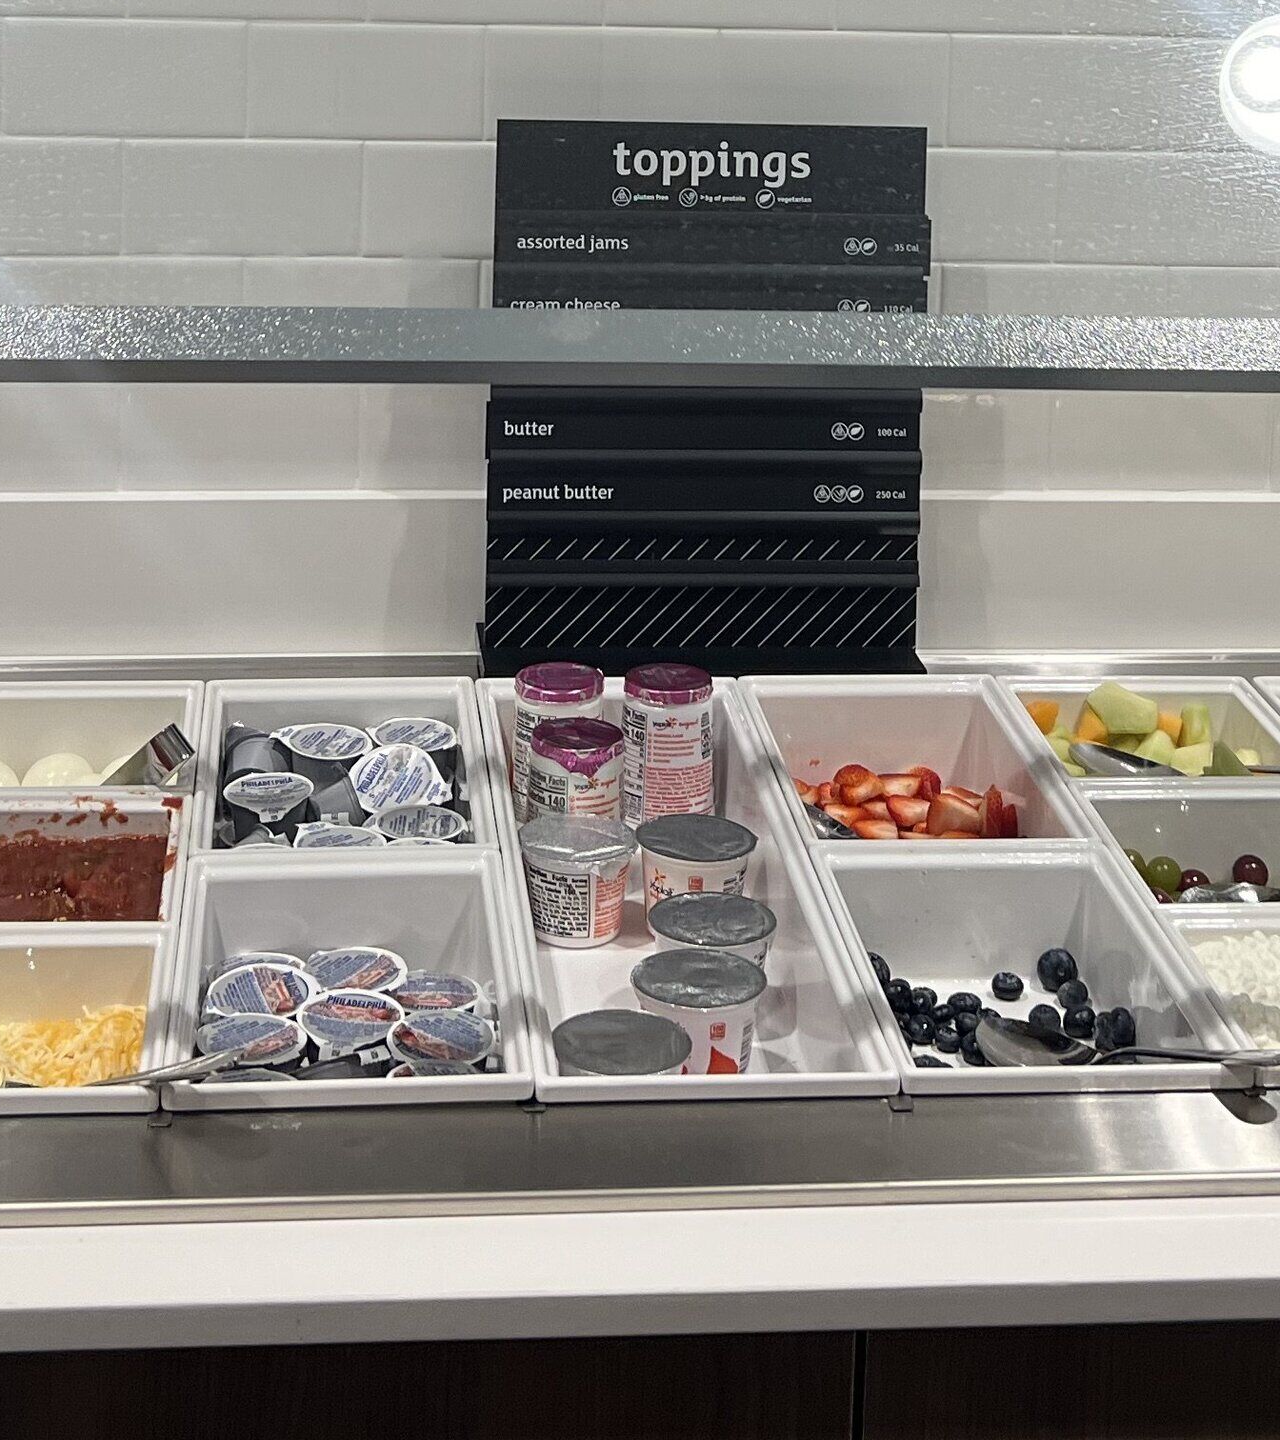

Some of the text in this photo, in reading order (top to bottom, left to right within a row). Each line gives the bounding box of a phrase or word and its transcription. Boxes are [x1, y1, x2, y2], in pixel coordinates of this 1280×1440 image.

[613, 141, 810, 187] toppings
[517, 235, 628, 253] assorted jams
[511, 298, 620, 309] cream cheese
[504, 421, 554, 435] butter
[503, 484, 614, 503] peanut butter
